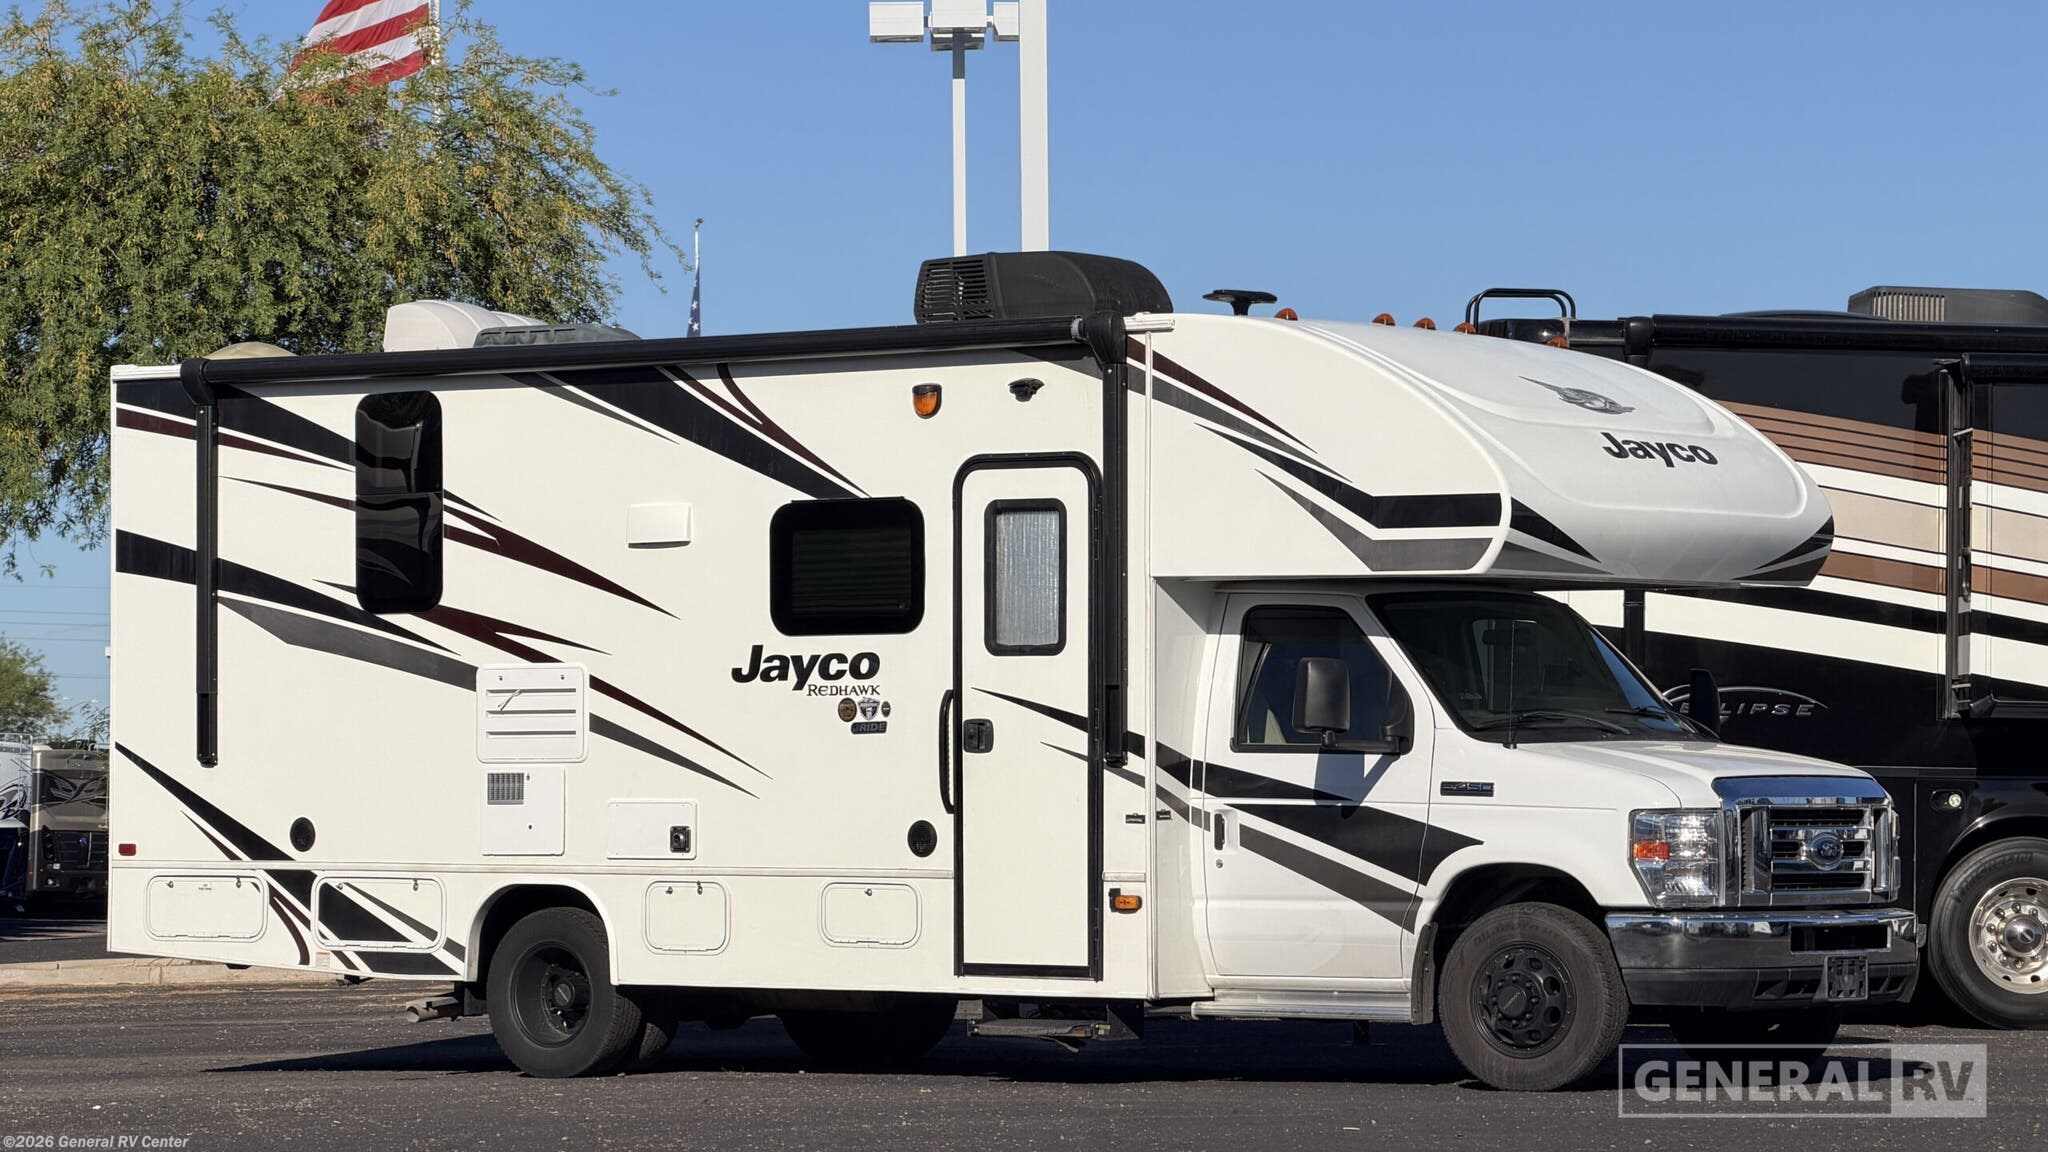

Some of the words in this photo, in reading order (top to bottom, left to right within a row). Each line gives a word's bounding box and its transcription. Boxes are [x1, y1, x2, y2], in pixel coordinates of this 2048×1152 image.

[1600, 432, 1718, 467] Jayco
[731, 645, 880, 690] Jayco
[1679, 702, 1815, 716] ELIPSE
